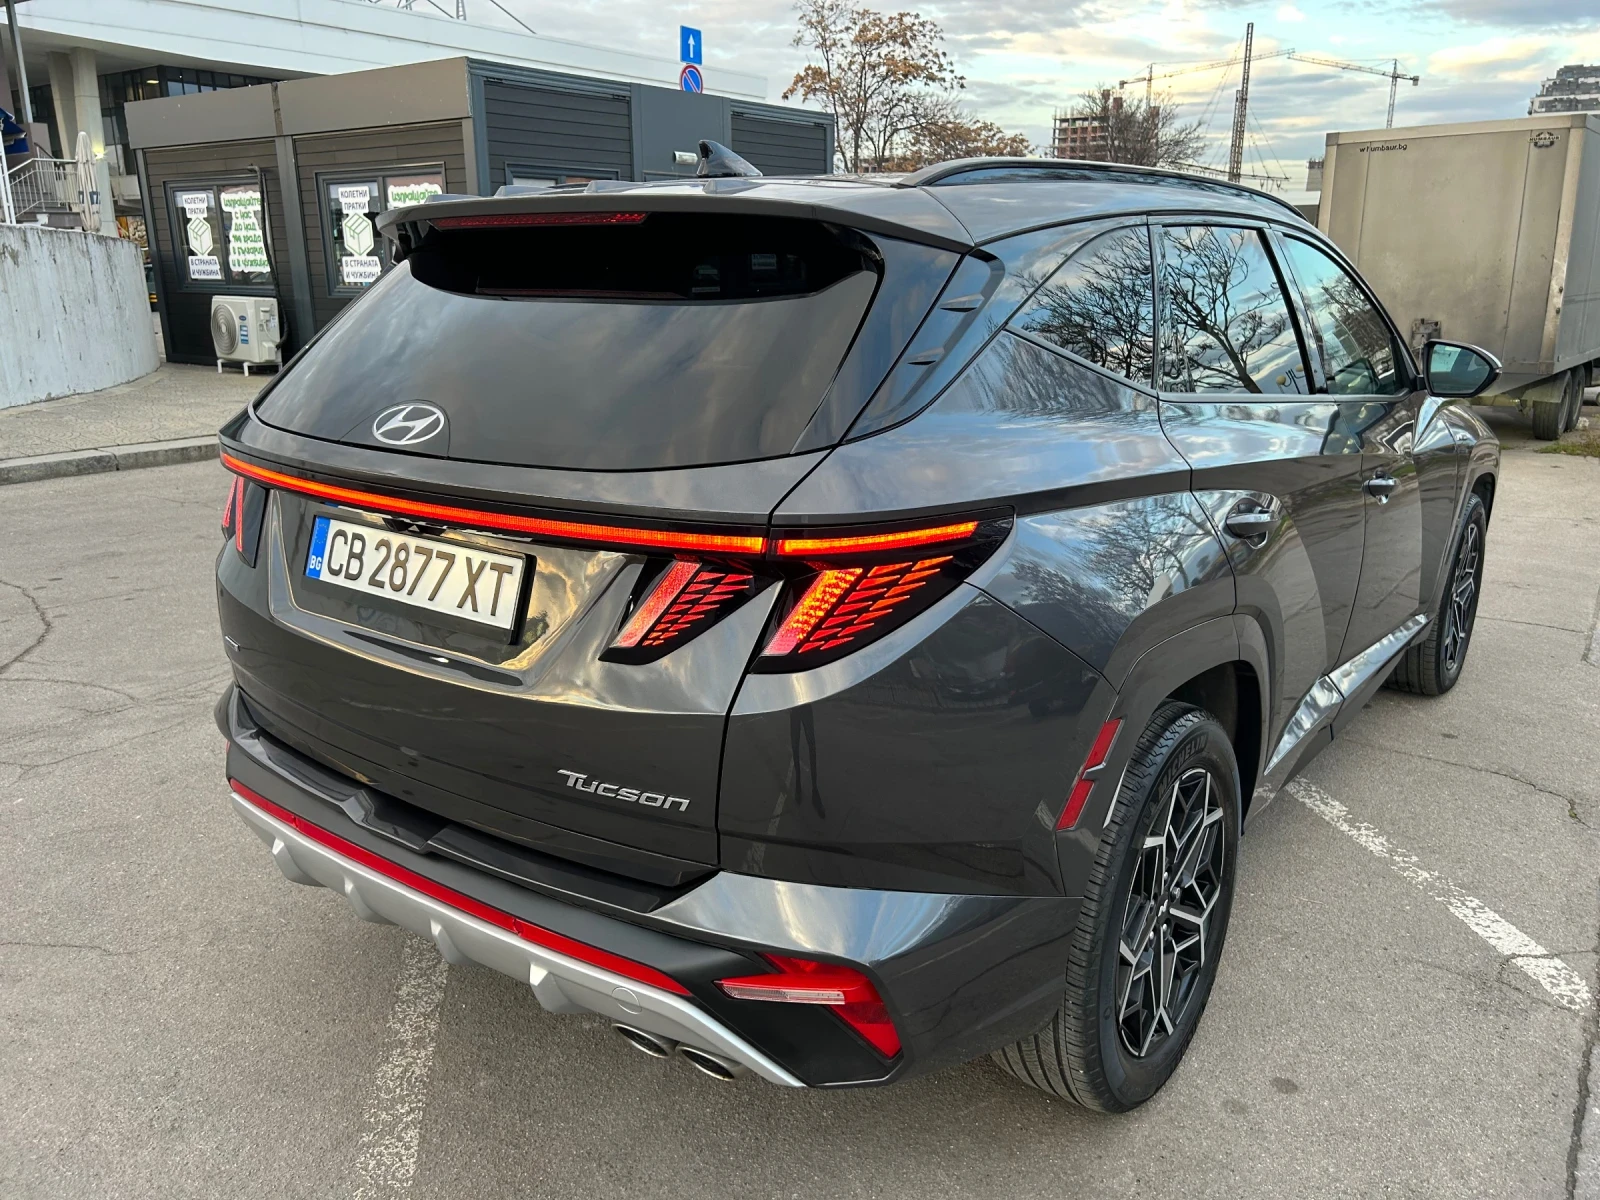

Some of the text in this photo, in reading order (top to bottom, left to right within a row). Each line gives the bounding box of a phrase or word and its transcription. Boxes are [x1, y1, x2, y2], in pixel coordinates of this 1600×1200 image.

[184, 196, 206, 204] КОЛЕТНИ
[340, 189, 368, 199] КОЛЕТНИ
[344, 202, 367, 210] ПРАТКИ
[349, 259, 379, 268] СТРАНАТА
[309, 554, 323, 571] BG
[327, 528, 514, 617] CB 2877 XT
[1158, 731, 1209, 801] MICHELIN
[557, 768, 691, 812] Tucson
